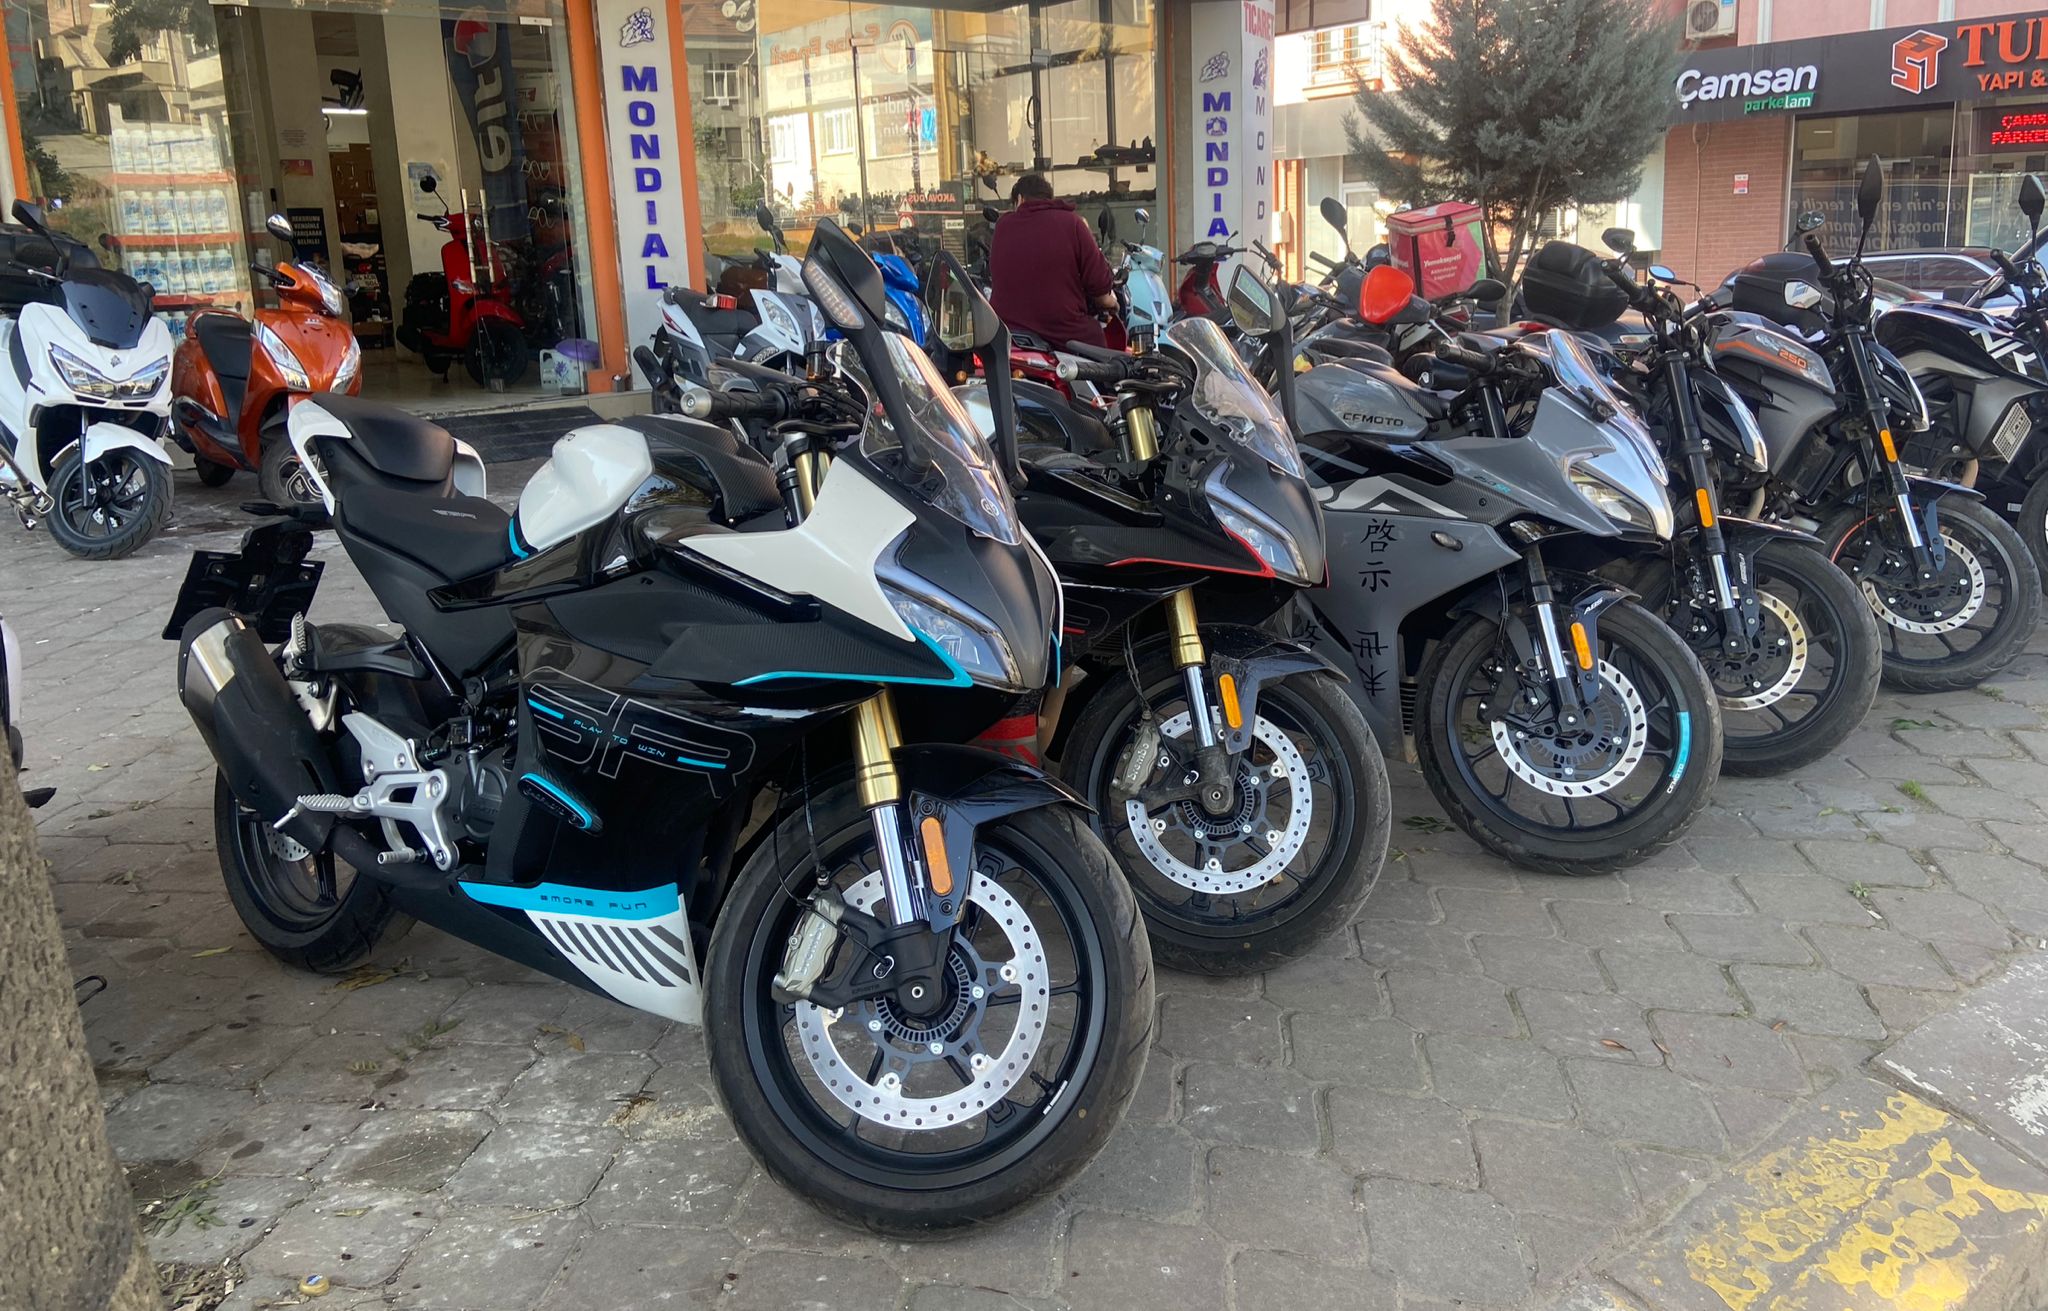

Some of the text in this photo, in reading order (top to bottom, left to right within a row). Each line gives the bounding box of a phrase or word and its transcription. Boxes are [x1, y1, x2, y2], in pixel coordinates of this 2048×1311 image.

[1675, 64, 1818, 110] Çamsan
[1977, 69, 2048, 91] YAPI &
[1744, 94, 1812, 114] parkelam
[621, 65, 669, 290] MONDIAL
[1203, 91, 1230, 237] MONDIA
[1778, 348, 1807, 370] 250
[1342, 412, 1404, 427] CFMOTO
[573, 719, 666, 757] PLAY TO WIN
[1128, 743, 1149, 781] brembo
[1666, 764, 1684, 794] CFMOTO
[609, 902, 648, 910] FUN
